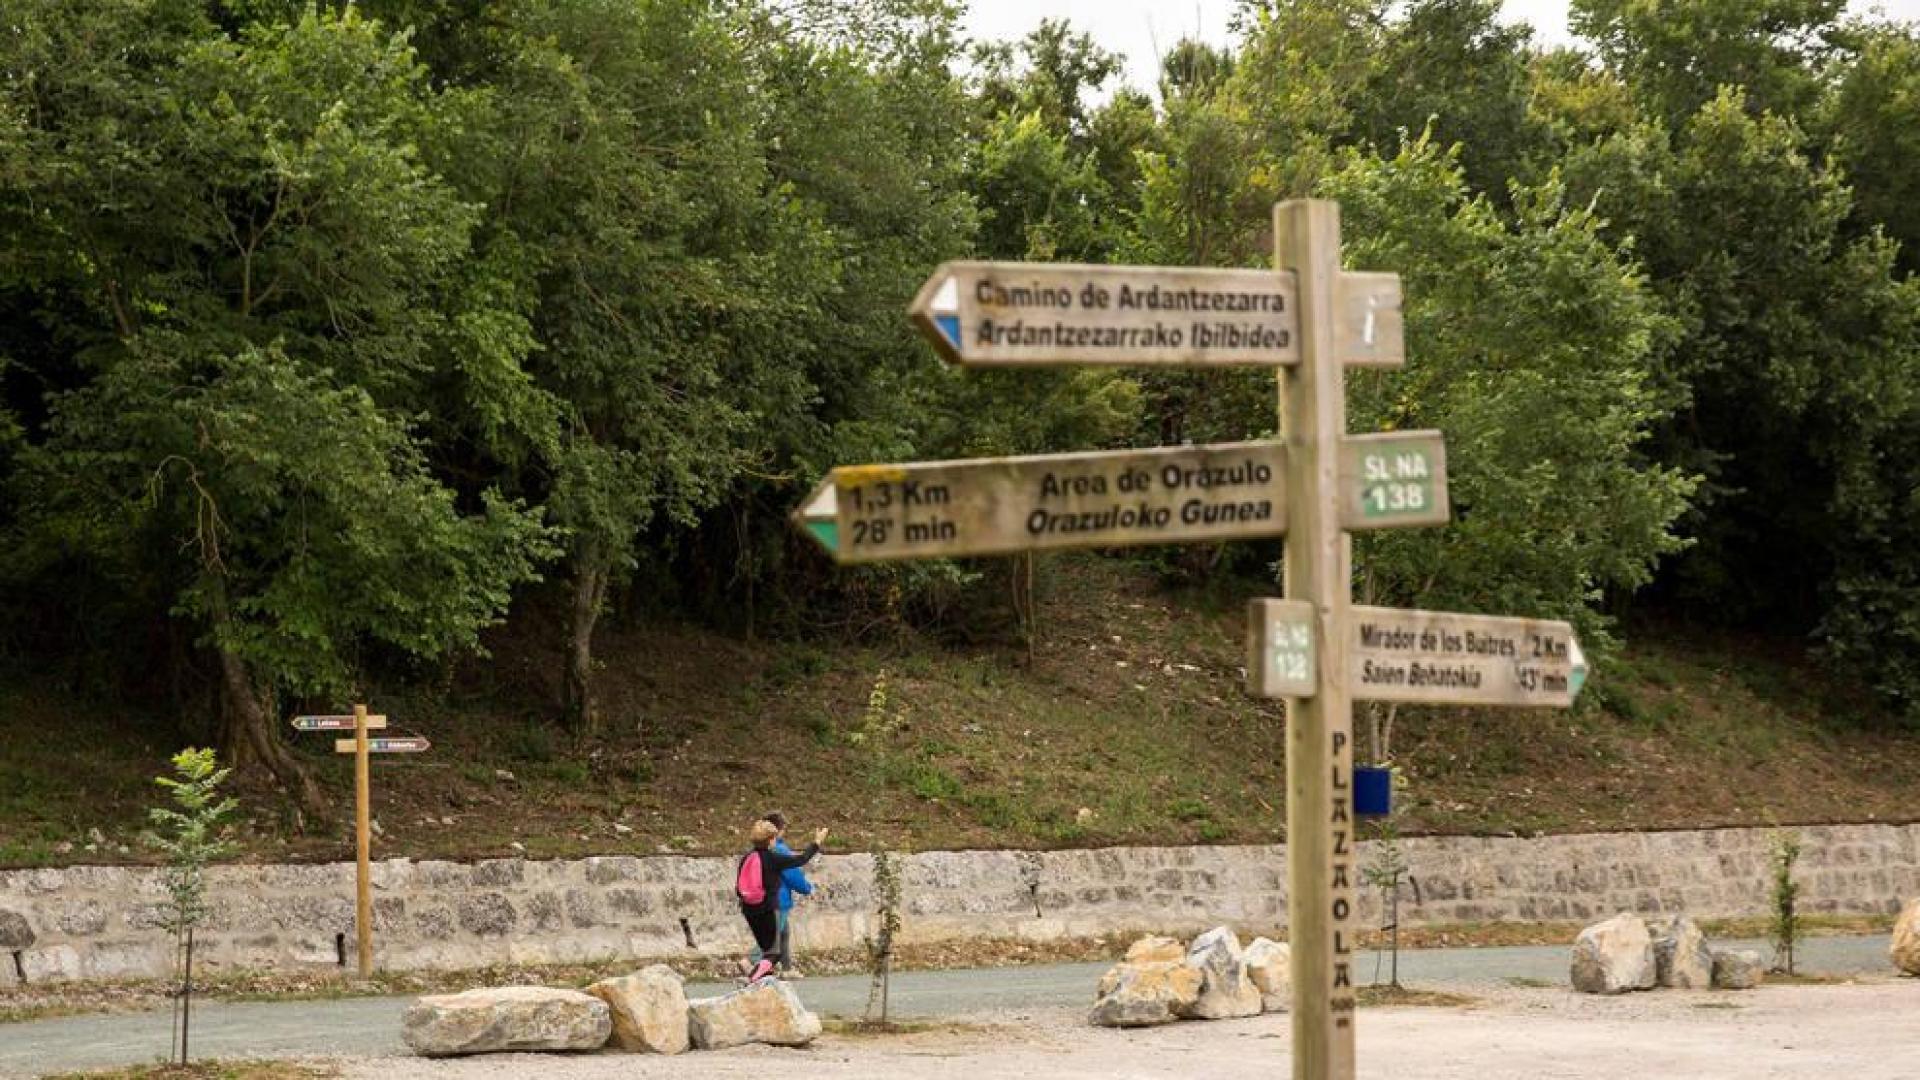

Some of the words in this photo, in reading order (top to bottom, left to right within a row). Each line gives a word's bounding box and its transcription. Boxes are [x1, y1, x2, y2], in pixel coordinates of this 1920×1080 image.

[977, 281, 1071, 308] Camino
[1080, 282, 1110, 309] de
[1119, 285, 1285, 312] Ardantzezarra
[977, 318, 1183, 347] Ardantzezarrako
[1191, 321, 1290, 348] Ibilbidea
[902, 481, 950, 505] Km
[1118, 468, 1150, 493] de
[1373, 484, 1424, 511] 138
[904, 516, 956, 541] min
[1027, 503, 1170, 534] Orazuloko
[1181, 498, 1271, 525] Gunea
[1360, 622, 1415, 650] Mirador
[1420, 628, 1437, 652] de
[1441, 629, 1462, 653] los
[1465, 629, 1515, 657] Buitres
[1533, 633, 1542, 657] 2
[1361, 659, 1404, 684] Saien
[1408, 662, 1481, 689] Behatokia
[1543, 671, 1567, 691] min
[1331, 732, 1350, 988] PLAZAOLA
